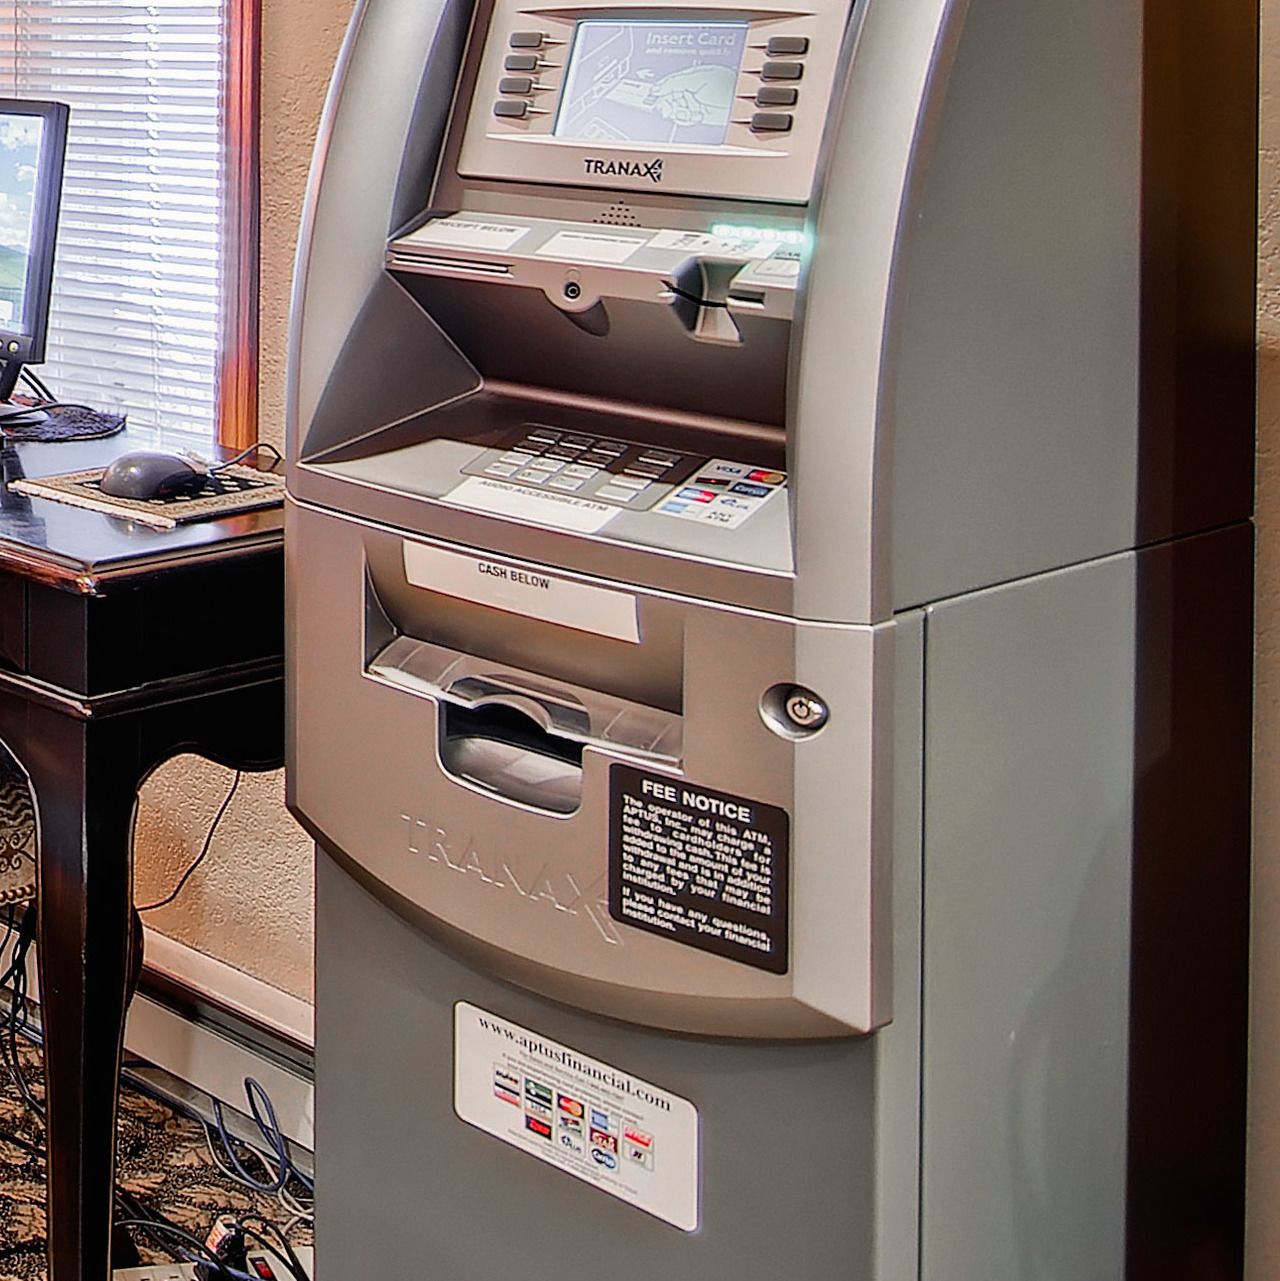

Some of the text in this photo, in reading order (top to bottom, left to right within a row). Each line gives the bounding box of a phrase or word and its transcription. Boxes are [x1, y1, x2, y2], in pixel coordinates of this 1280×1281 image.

[646, 32, 736, 46] Insert Card
[584, 158, 662, 183] TRANAX
[513, 488, 581, 506] ACCESSIBLE
[582, 502, 608, 512] ATM
[478, 562, 550, 590] CASH BELOW
[623, 794, 643, 809] The
[648, 801, 692, 823] operator
[698, 818, 711, 829] of
[715, 820, 738, 836] this
[642, 779, 751, 823] FEE NOTICE
[623, 814, 771, 865] fee to cardholders for
[623, 825, 771, 875] withdrawing cash. This fee is
[623, 835, 771, 886] added to the amount of your
[690, 825, 713, 840] may
[717, 831, 755, 852] charge
[764, 847, 771, 855] a
[623, 844, 771, 895] withdrawal and is in addition
[623, 852, 771, 905] to any fees that may be
[623, 862, 771, 916] charged by your financial
[622, 886, 771, 943] If you have any questions,
[623, 897, 770, 952] please contact your financial
[479, 1017, 671, 1111] www.aptusfinancial.com
